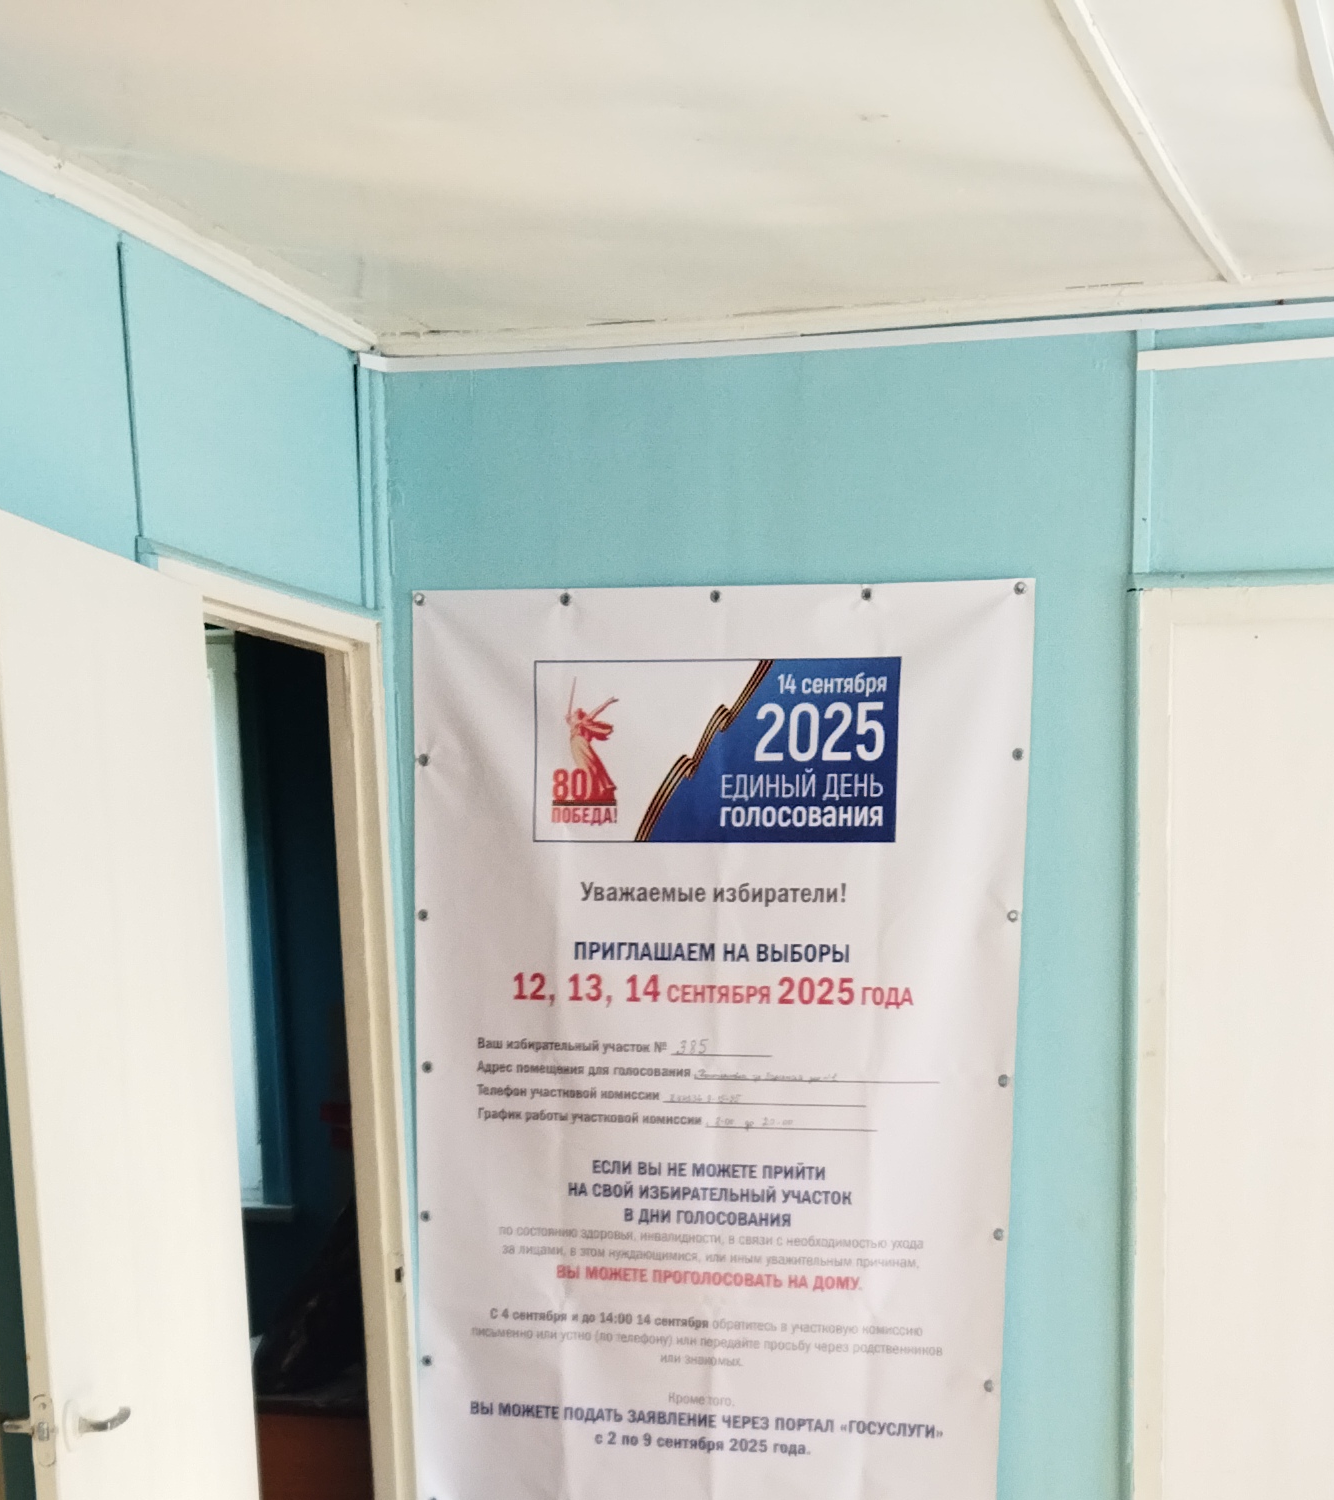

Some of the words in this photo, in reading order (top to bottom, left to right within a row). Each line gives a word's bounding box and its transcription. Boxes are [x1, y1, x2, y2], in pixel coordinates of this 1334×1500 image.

[778, 674, 797, 694] 14
[801, 673, 888, 697] сентября
[754, 702, 887, 762] 2025
[552, 768, 589, 801] 80
[720, 769, 817, 801] ЕДИНЫЙ
[822, 772, 885, 801] ДЕНЬ
[551, 806, 618, 826] ПОБЕДА!
[720, 805, 885, 829] голосования
[580, 881, 706, 902] Уважаемые
[712, 882, 846, 906] избиратели!
[574, 941, 715, 962] ПРИГЛАШАЕМ
[723, 943, 749, 962] НА
[756, 943, 849, 963] ВЫБОРЫ
[513, 972, 555, 1004] 12,
[568, 973, 611, 1005] 13,
[626, 974, 661, 1002] 14
[666, 984, 770, 1004] СЕНТЯБРЯ
[777, 976, 854, 1005] 2025
[861, 986, 913, 1009] ГОДА
[477, 1036, 503, 1049] Ваш
[505, 1037, 599, 1053] избирательный
[601, 1042, 650, 1055] участок
[653, 1041, 667, 1053] №
[476, 1060, 513, 1075] Адрес
[515, 1063, 584, 1076] помещения
[587, 1066, 609, 1077] для
[613, 1066, 690, 1077] голосования
[476, 1083, 527, 1098] Телефон
[529, 1086, 597, 1100] участковой
[600, 1090, 659, 1100] комиссии
[477, 1106, 522, 1122] График
[525, 1110, 568, 1122] работы
[571, 1112, 639, 1125] участковой
[642, 1115, 701, 1125] комиссии
[592, 1159, 631, 1175] ЕСЛИ
[637, 1161, 661, 1176] ВЫ
[667, 1162, 687, 1177] НЕ
[691, 1162, 757, 1179] МОЖЕТЕ
[761, 1164, 825, 1180] ПРИЙТИ
[568, 1182, 587, 1197] НА
[591, 1182, 633, 1198] СВОЙ
[638, 1184, 776, 1203] ИЗБИРАТЕЛЬНЫЙ
[781, 1189, 851, 1205] УЧАСТОК
[623, 1207, 633, 1222] В
[637, 1208, 671, 1225] ДНИ
[676, 1209, 791, 1227] ГОЛОСОВАНИЯ
[498, 1226, 513, 1236] по
[516, 1226, 578, 1238] состоянию
[580, 1228, 636, 1242] здоровья,
[639, 1232, 725, 1246] инвалидности,
[728, 1234, 735, 1245] в
[738, 1235, 773, 1246] связи
[776, 1236, 783, 1246] с
[786, 1235, 887, 1249] необходимостью
[891, 1239, 923, 1251] ухода
[501, 1244, 515, 1255] за
[518, 1245, 567, 1260] лицами,
[569, 1246, 576, 1257] в
[579, 1247, 605, 1258] этом
[608, 1248, 700, 1263] нуждающимися,
[705, 1253, 726, 1263] или
[729, 1254, 762, 1264] иным
[765, 1255, 852, 1267] уважительным
[556, 1263, 580, 1280] ВЫ
[585, 1265, 648, 1283] МОЖЕТЕ
[652, 1269, 783, 1288] ПРОГОЛОСОВАТЬ
[787, 1274, 808, 1288] НА
[489, 1307, 498, 1320] С
[500, 1308, 509, 1319] 4
[511, 1309, 567, 1324] сентября
[571, 1314, 579, 1323] и
[581, 1313, 596, 1325] до
[599, 1311, 633, 1325] 14:00
[636, 1313, 651, 1325] 14
[654, 1315, 709, 1331] сентября
[712, 1318, 776, 1331] обратитесь
[780, 1323, 787, 1331] в
[791, 1323, 859, 1337] участковую
[863, 1325, 923, 1337] комиссию
[471, 1326, 534, 1340] письменно
[534, 1330, 558, 1340] или
[558, 1330, 592, 1343] устно
[593, 1329, 613, 1344] (по
[615, 1332, 672, 1347] телефону)
[676, 1336, 697, 1346] или
[699, 1336, 760, 1352] передайте
[763, 1339, 811, 1353] просьбу
[814, 1342, 849, 1354] через
[852, 1343, 943, 1357] родственников
[470, 1400, 494, 1416] ВЫ
[498, 1402, 560, 1421] МОЖЕТЕ
[563, 1406, 623, 1424] ПОДАТЬ
[627, 1409, 716, 1429] ЗАЯВЛЕНИЕ
[721, 1414, 769, 1430] ЧЕРЕЗ
[774, 1416, 834, 1433] ПОРТАЛ
[840, 1420, 943, 1439] «ГОСУСЛУГИ»
[594, 1433, 603, 1444] с
[607, 1430, 616, 1445] 2
[621, 1434, 639, 1446] по
[642, 1432, 652, 1447] 9
[656, 1435, 724, 1454] сентября
[729, 1437, 768, 1453] 2025
